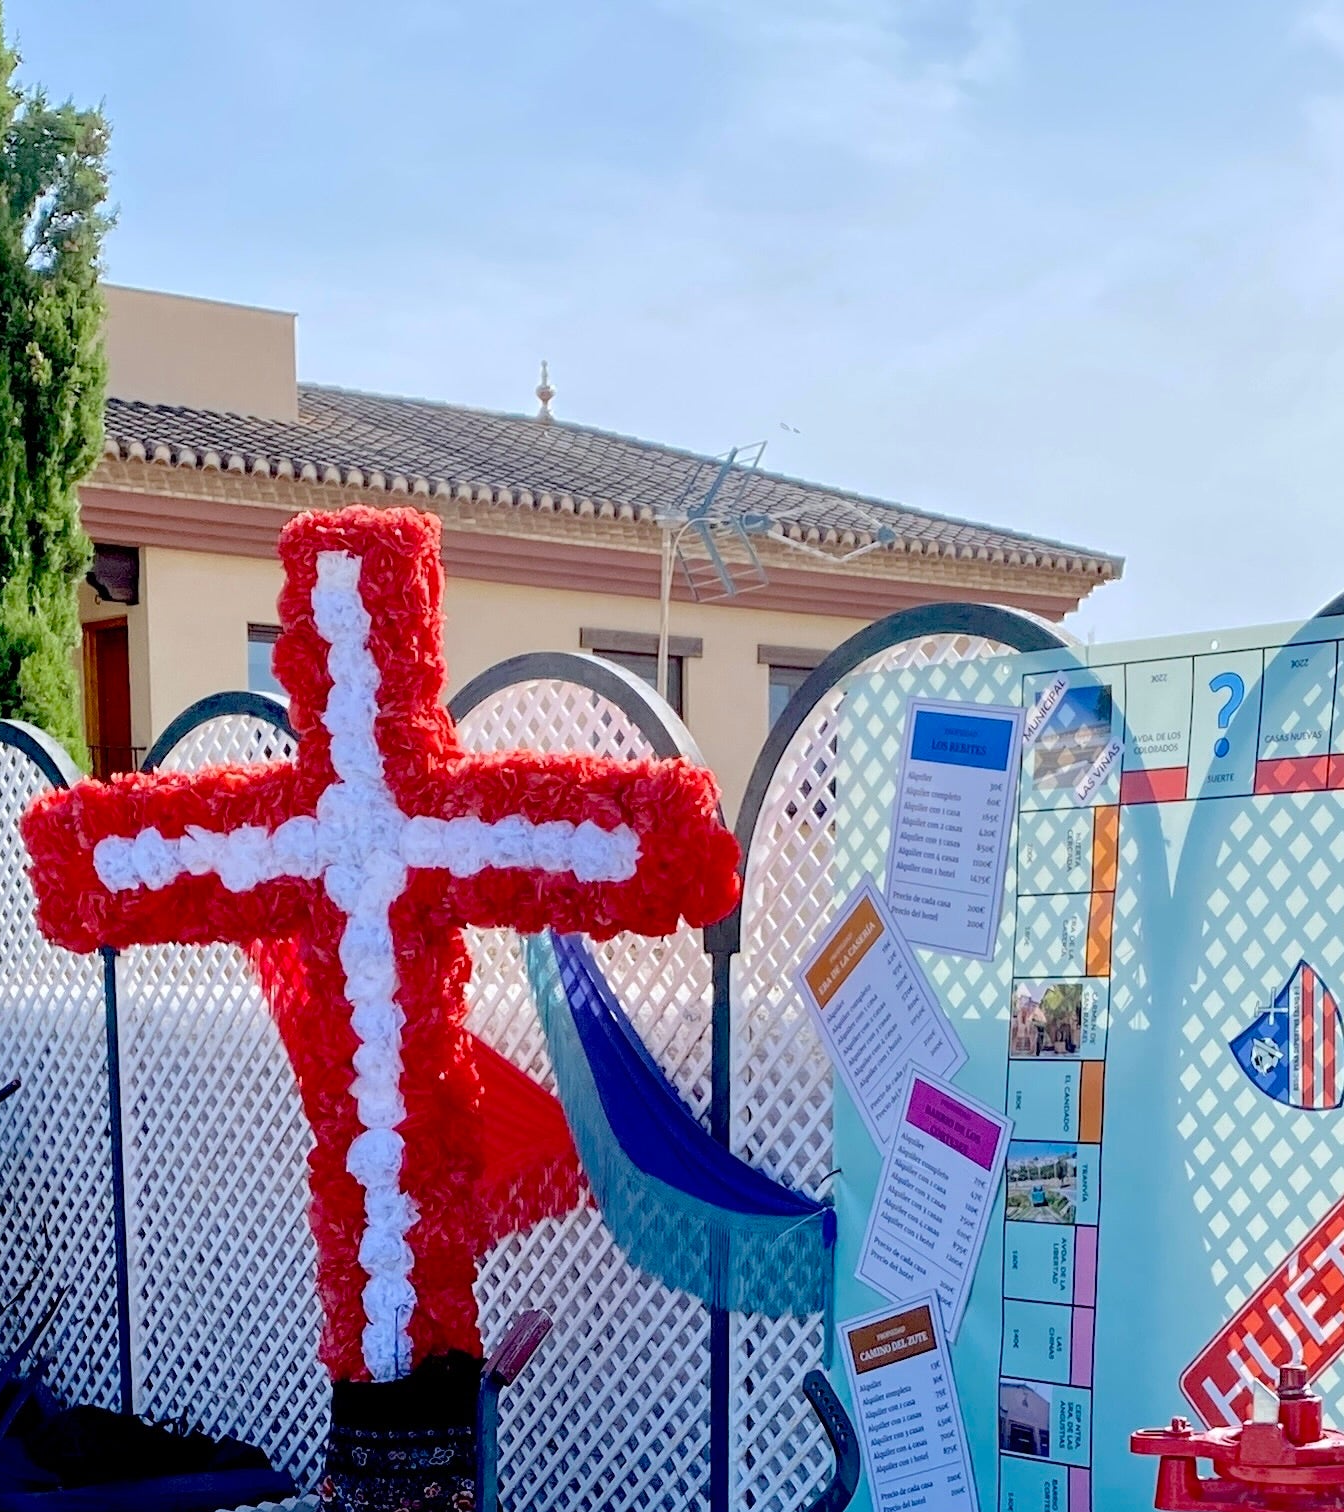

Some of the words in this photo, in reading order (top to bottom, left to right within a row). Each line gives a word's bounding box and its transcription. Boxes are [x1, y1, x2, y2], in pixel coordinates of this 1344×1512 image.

[1023, 678, 1067, 742] MUNICIPAL
[1265, 733, 1289, 743] CASAS
[1291, 730, 1323, 741] NUEVAS
[1064, 1074, 1071, 1086] EL
[1063, 1088, 1071, 1133] CANDADO
